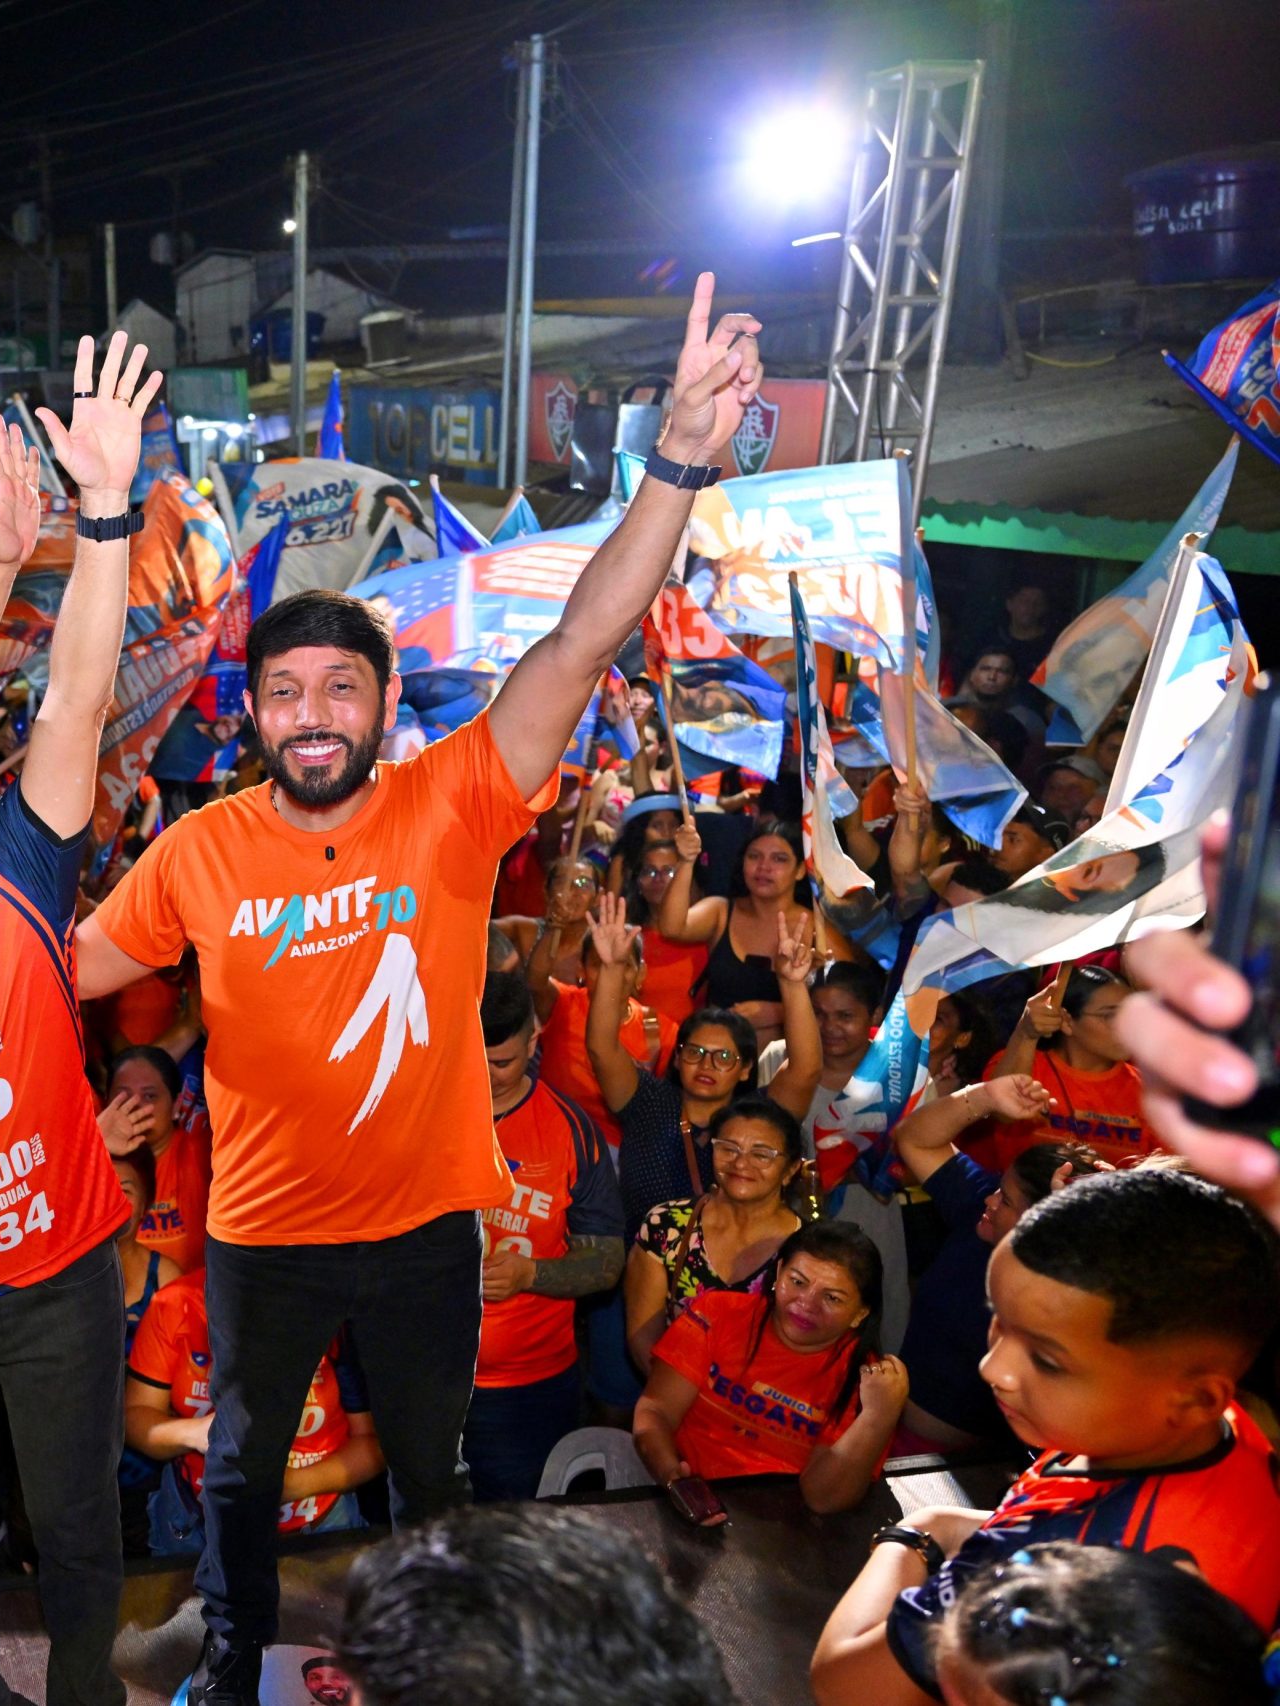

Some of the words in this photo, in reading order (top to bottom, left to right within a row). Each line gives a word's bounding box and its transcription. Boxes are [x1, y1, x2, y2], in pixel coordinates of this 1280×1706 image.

[430, 404, 498, 466] CELL
[255, 479, 354, 519] SAMARA
[373, 884, 418, 931] 70
[888, 1040, 903, 1104] ESTADUAL
[30, 1132, 47, 1167] ASSIS
